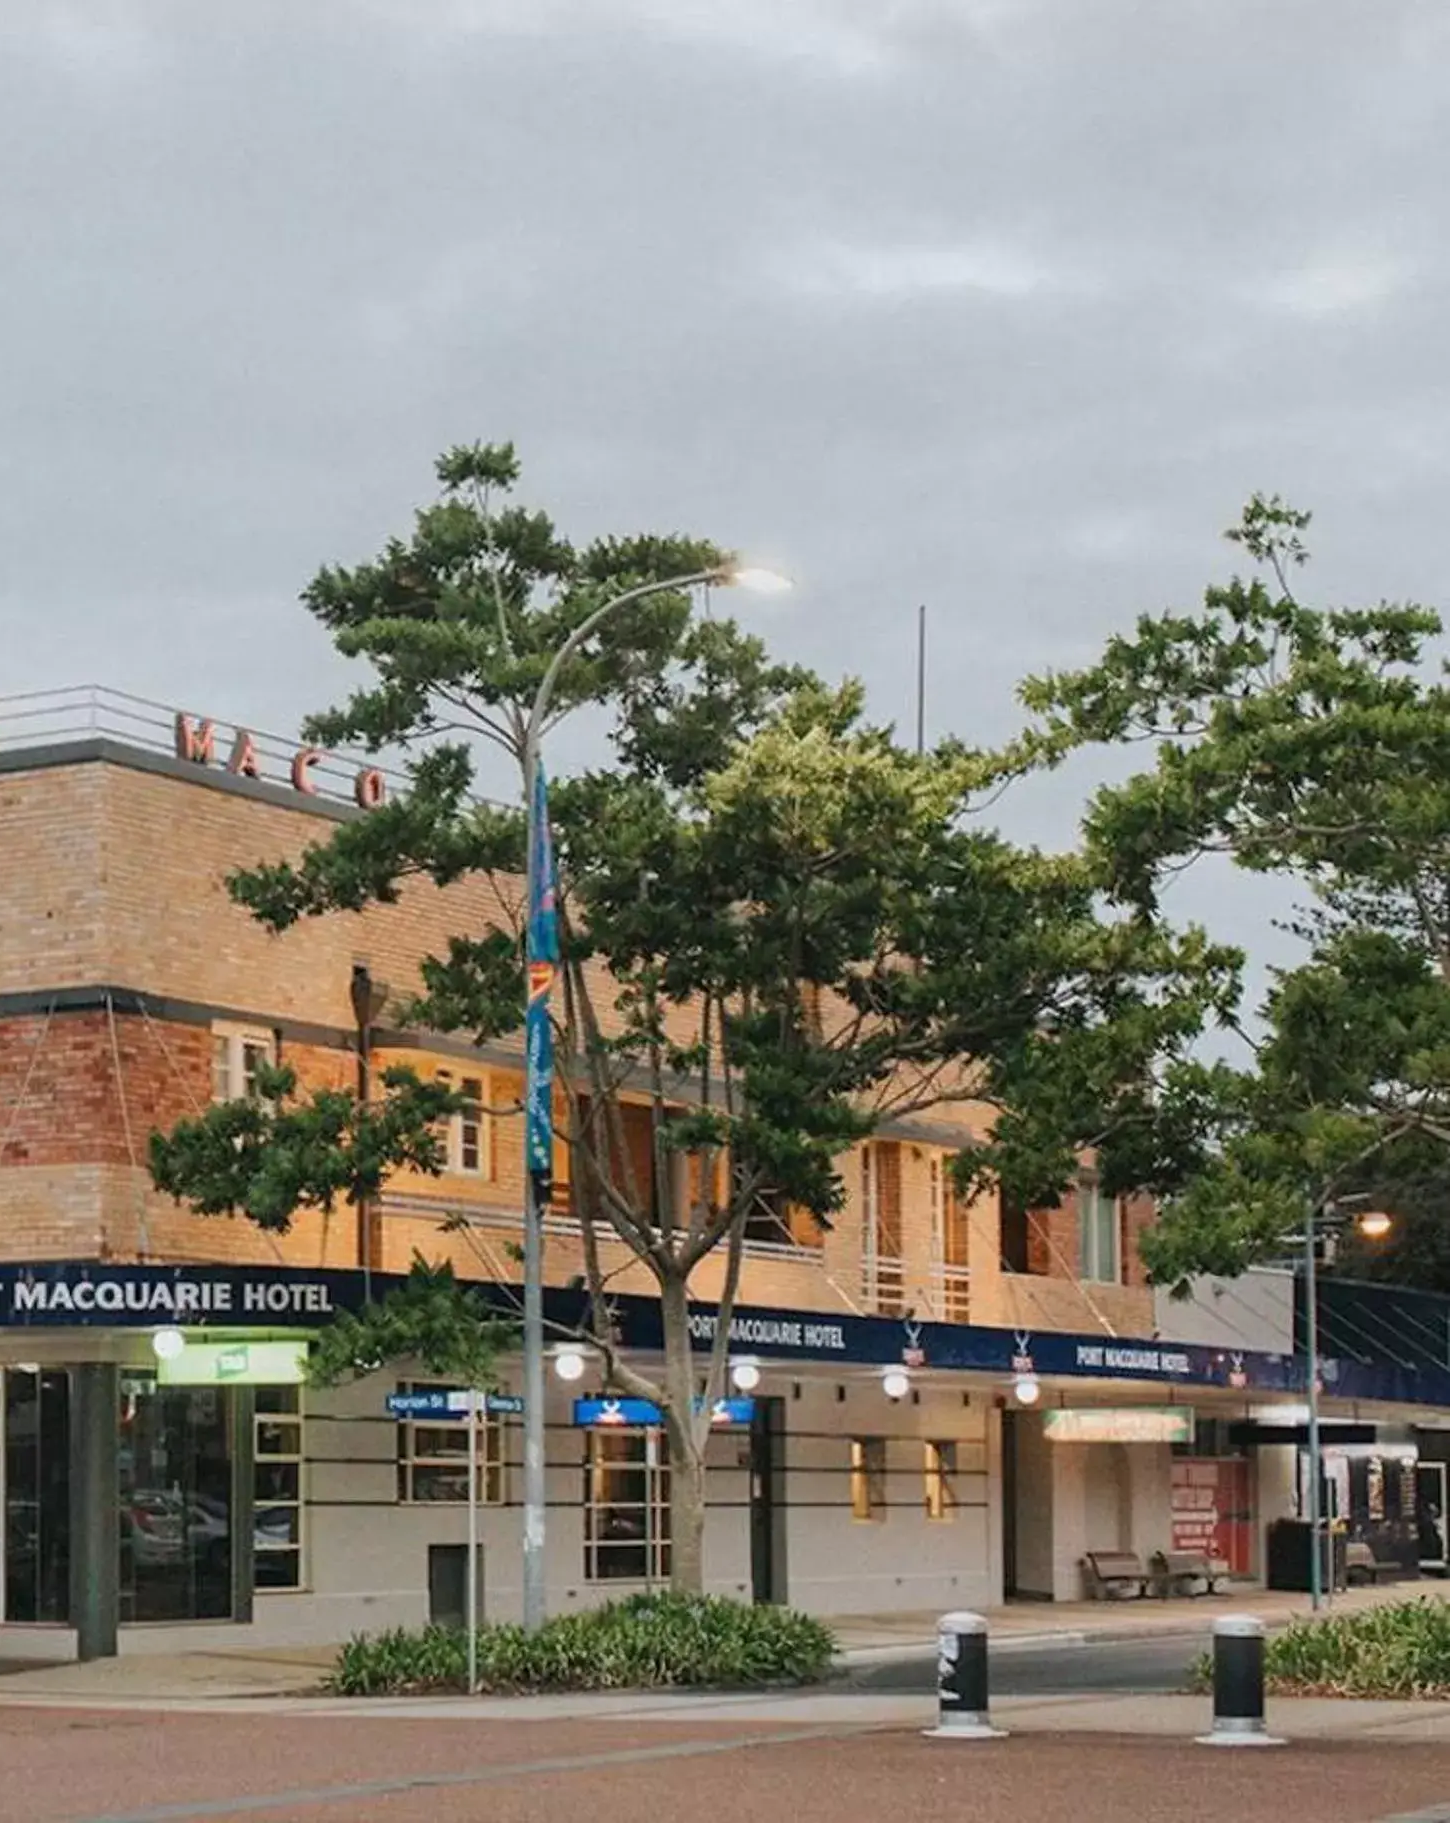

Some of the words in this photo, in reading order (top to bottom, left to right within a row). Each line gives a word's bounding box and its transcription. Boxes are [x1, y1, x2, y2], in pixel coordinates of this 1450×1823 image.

[13, 1282, 232, 1311] MACQUARIE
[244, 1284, 333, 1312] HOTEL
[804, 1325, 846, 1348] HOTEL
